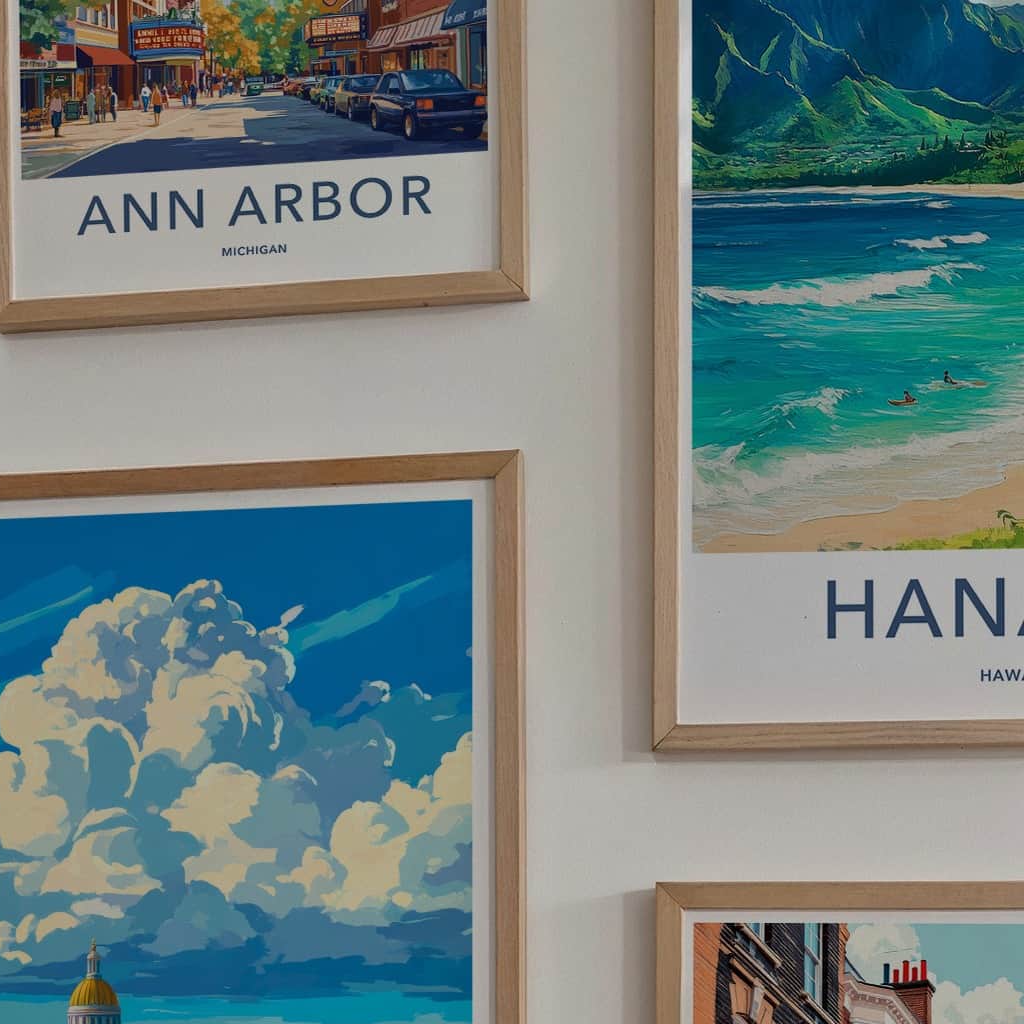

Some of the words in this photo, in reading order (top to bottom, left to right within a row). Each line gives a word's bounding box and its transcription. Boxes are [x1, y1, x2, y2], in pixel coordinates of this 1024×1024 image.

[77, 189, 205, 236] ANN
[228, 175, 432, 227] ARBOR
[221, 243, 288, 257] MICHIGAN
[826, 577, 1024, 639] HAN
[980, 668, 1024, 682] HAW
